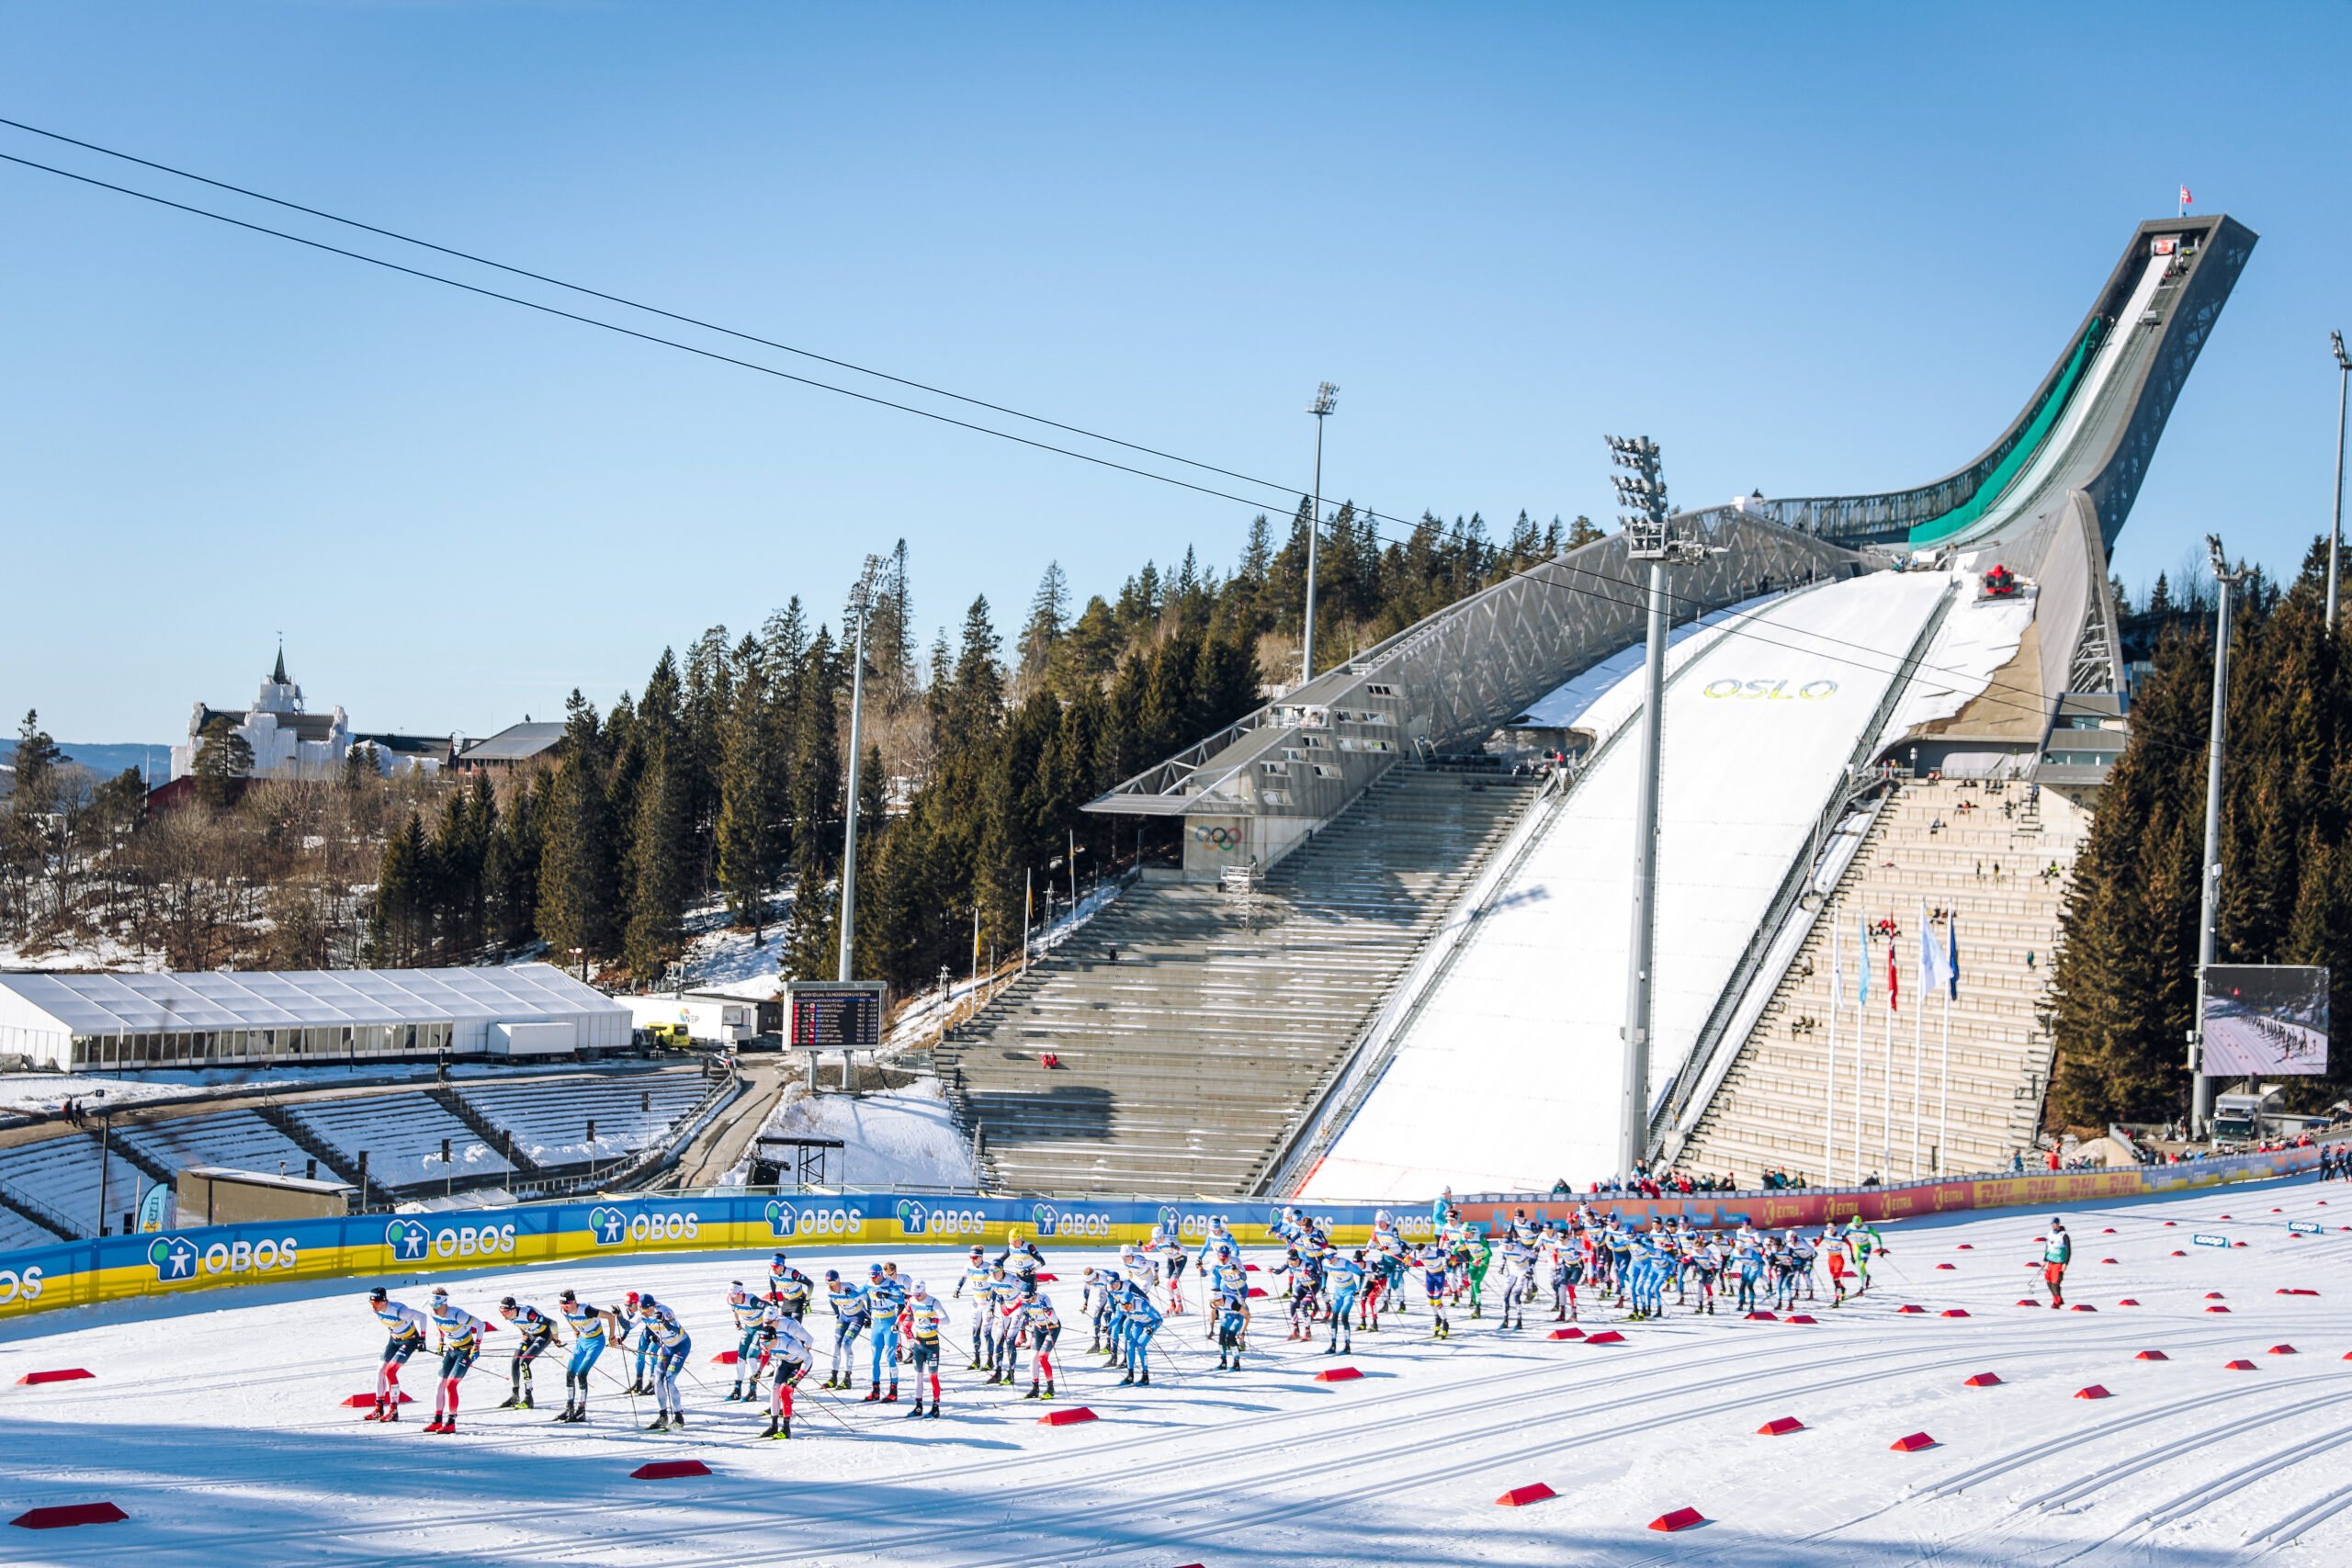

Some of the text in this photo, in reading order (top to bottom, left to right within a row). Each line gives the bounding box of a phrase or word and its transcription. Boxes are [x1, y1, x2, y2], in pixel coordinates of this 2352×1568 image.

[1703, 678, 1838, 699] OSLO
[1980, 1182, 2014, 1204] DHL
[2026, 1179, 2058, 1200] DHL
[2068, 1177, 2098, 1197] DHL
[2109, 1175, 2138, 1194] DHL
[1891, 1196, 1913, 1211] EXTRA
[1944, 1190, 1964, 1203] EXTRA
[1776, 1205, 1800, 1219] EXTRA
[1837, 1201, 1860, 1215] EXTRA
[631, 1211, 699, 1241] OBOS
[799, 1208, 862, 1235] OBOS
[931, 1209, 985, 1235] OBOS
[1060, 1212, 1110, 1236] OBOS
[1313, 1215, 1333, 1237] OS
[1394, 1215, 1432, 1235] OBOS
[2290, 1223, 2317, 1232] coop
[435, 1224, 516, 1258] OBOS
[2195, 1235, 2224, 1246] coop
[204, 1236, 299, 1275] OBOS
